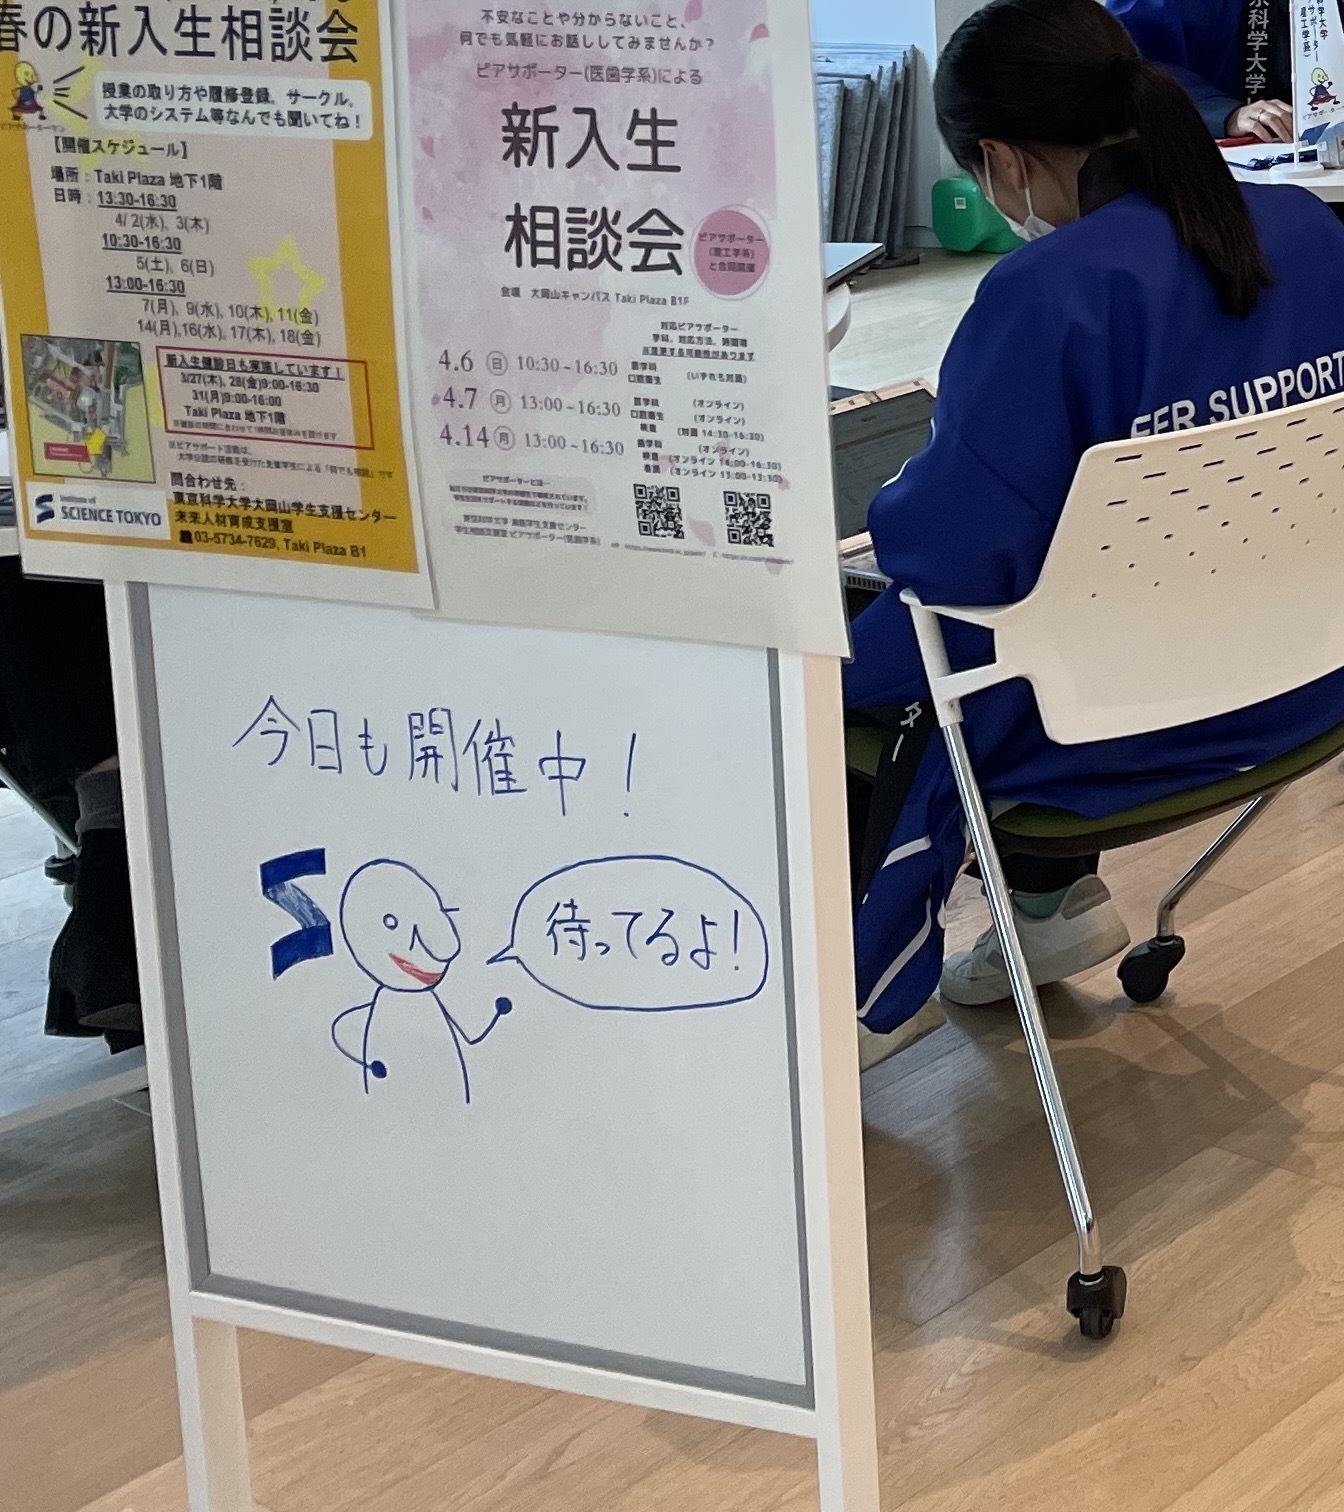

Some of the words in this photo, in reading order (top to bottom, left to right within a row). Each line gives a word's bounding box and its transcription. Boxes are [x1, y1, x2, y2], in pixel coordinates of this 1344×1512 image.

[481, 8, 686, 28] 不安なことや分からないこと、
[54, 135, 189, 159] 【開催スケジュール】
[501, 101, 681, 173] 新入生
[94, 169, 124, 184] Taki
[128, 171, 166, 186] Plaza
[170, 172, 223, 190] 地下1階
[97, 191, 177, 209] 13:30-16:30
[102, 233, 182, 250] 10:30-16:30
[504, 202, 685, 276] 相談会
[106, 275, 186, 294] 13:00-16:30
[615, 292, 637, 304] Taki
[639, 294, 667, 306] Plaza
[438, 349, 474, 373] 4.6
[442, 386, 478, 410] 4.7
[184, 405, 208, 417] Taki
[211, 408, 241, 420] Plaza
[245, 409, 286, 425] 地下1階
[440, 423, 489, 448] 4.14
[61, 506, 113, 523] SCIENCE
[116, 509, 161, 526] TOKYO
[283, 538, 310, 553] Taki
[313, 541, 347, 556] Plaza
[350, 544, 367, 558] B1
[232, 694, 637, 817] 今日も開催中！
[546, 898, 741, 972] 待ってるよ！
